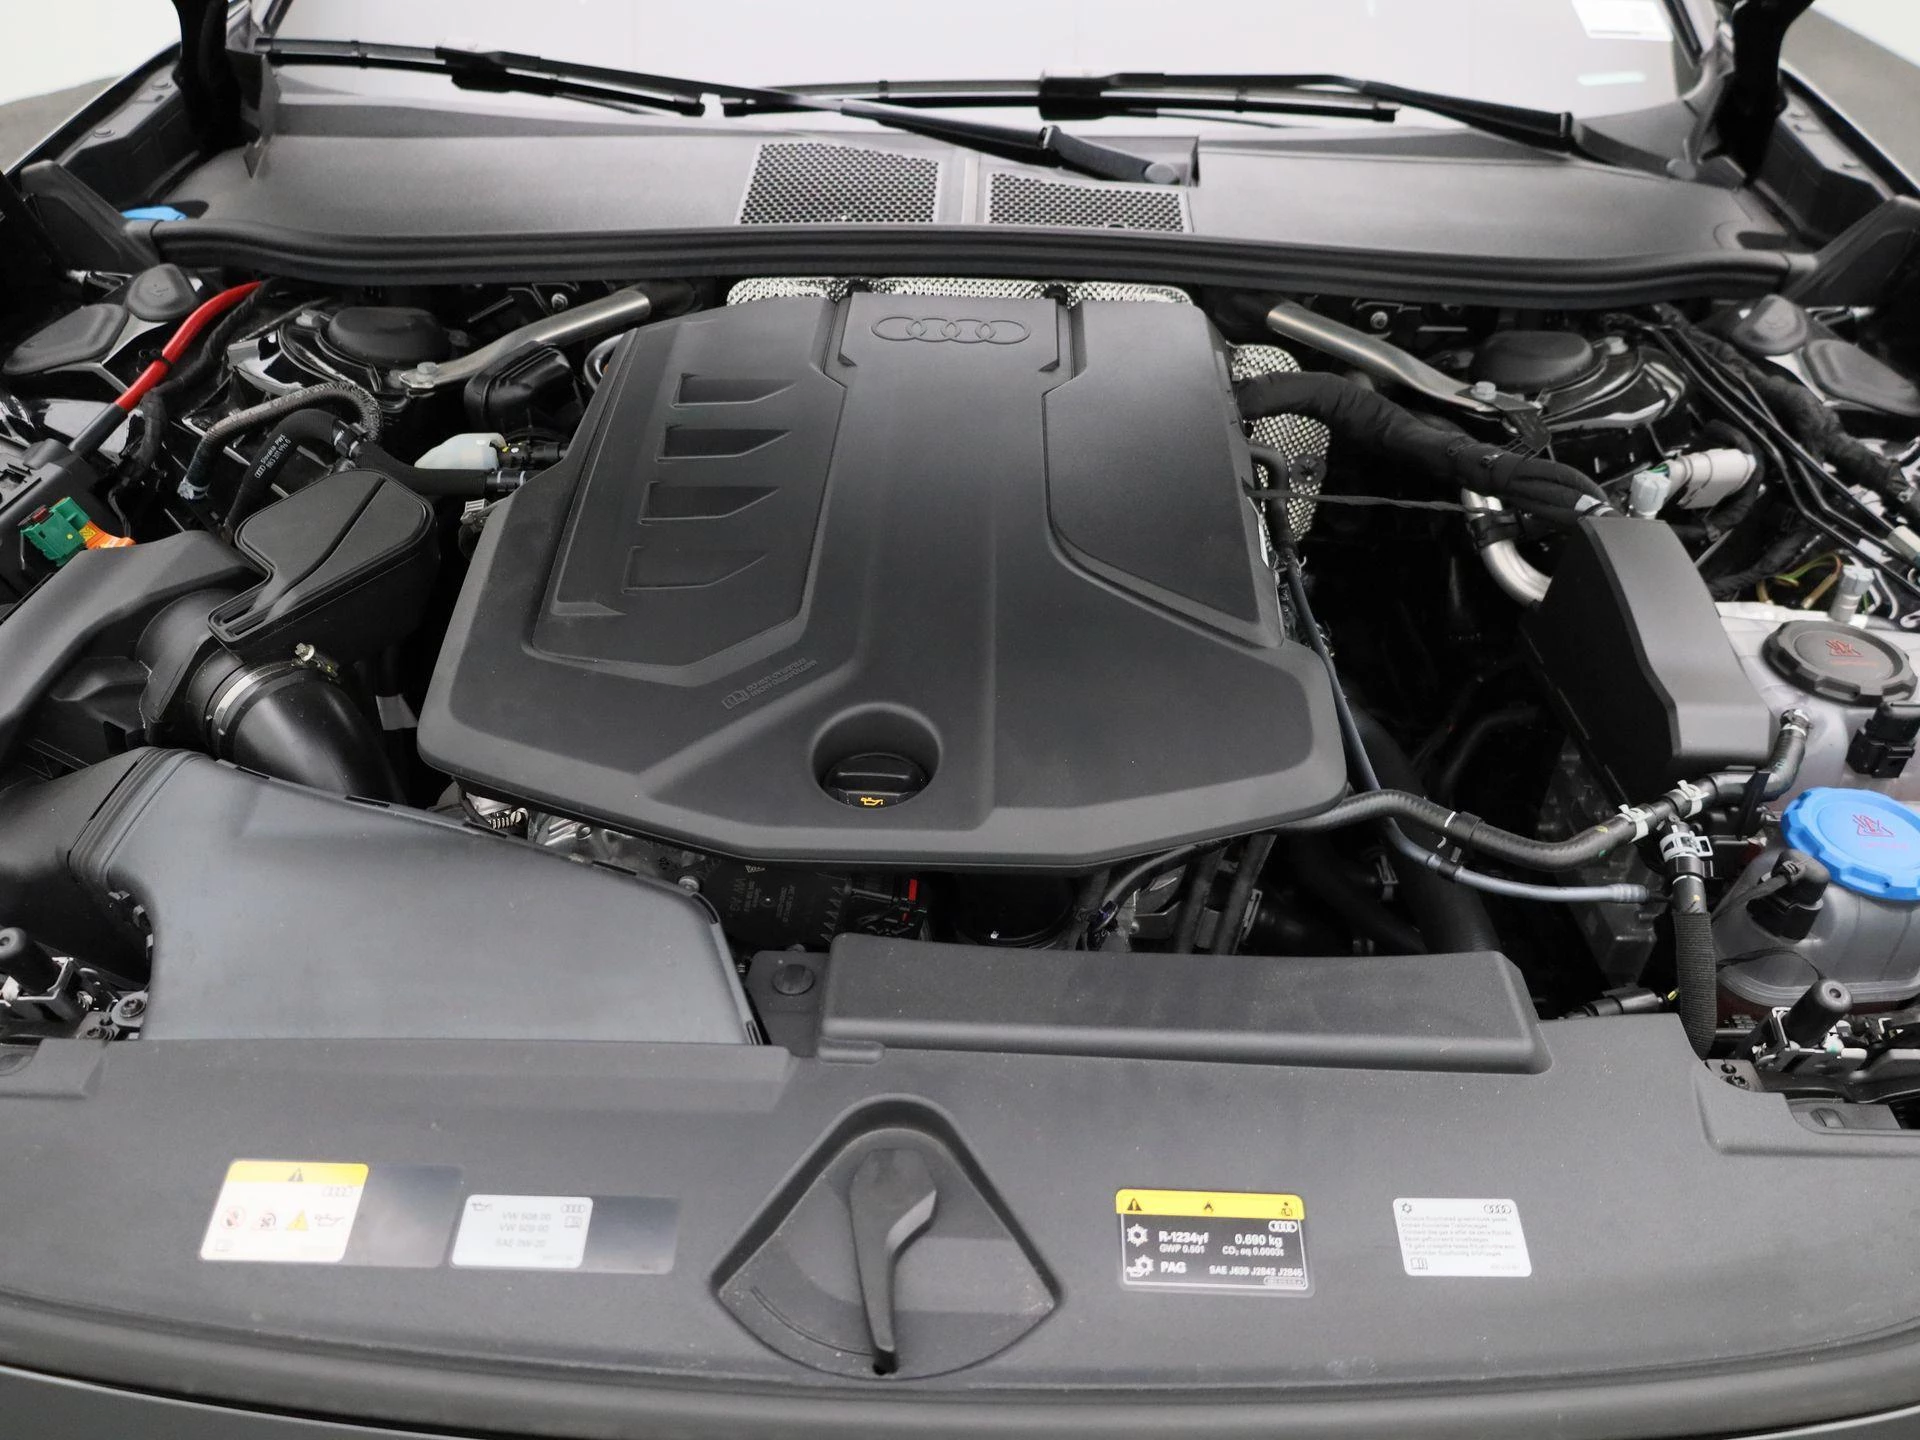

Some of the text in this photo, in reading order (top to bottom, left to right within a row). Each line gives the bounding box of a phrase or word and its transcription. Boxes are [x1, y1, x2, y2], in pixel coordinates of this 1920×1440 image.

[502, 1211, 518, 1220] VW
[499, 1223, 516, 1232] VW
[1158, 1230, 1209, 1245] R-1234yf
[1268, 1234, 1283, 1249] kg
[1159, 1243, 1182, 1253] GWP
[1160, 1261, 1187, 1274] PAG
[1209, 1265, 1227, 1275] SAE
